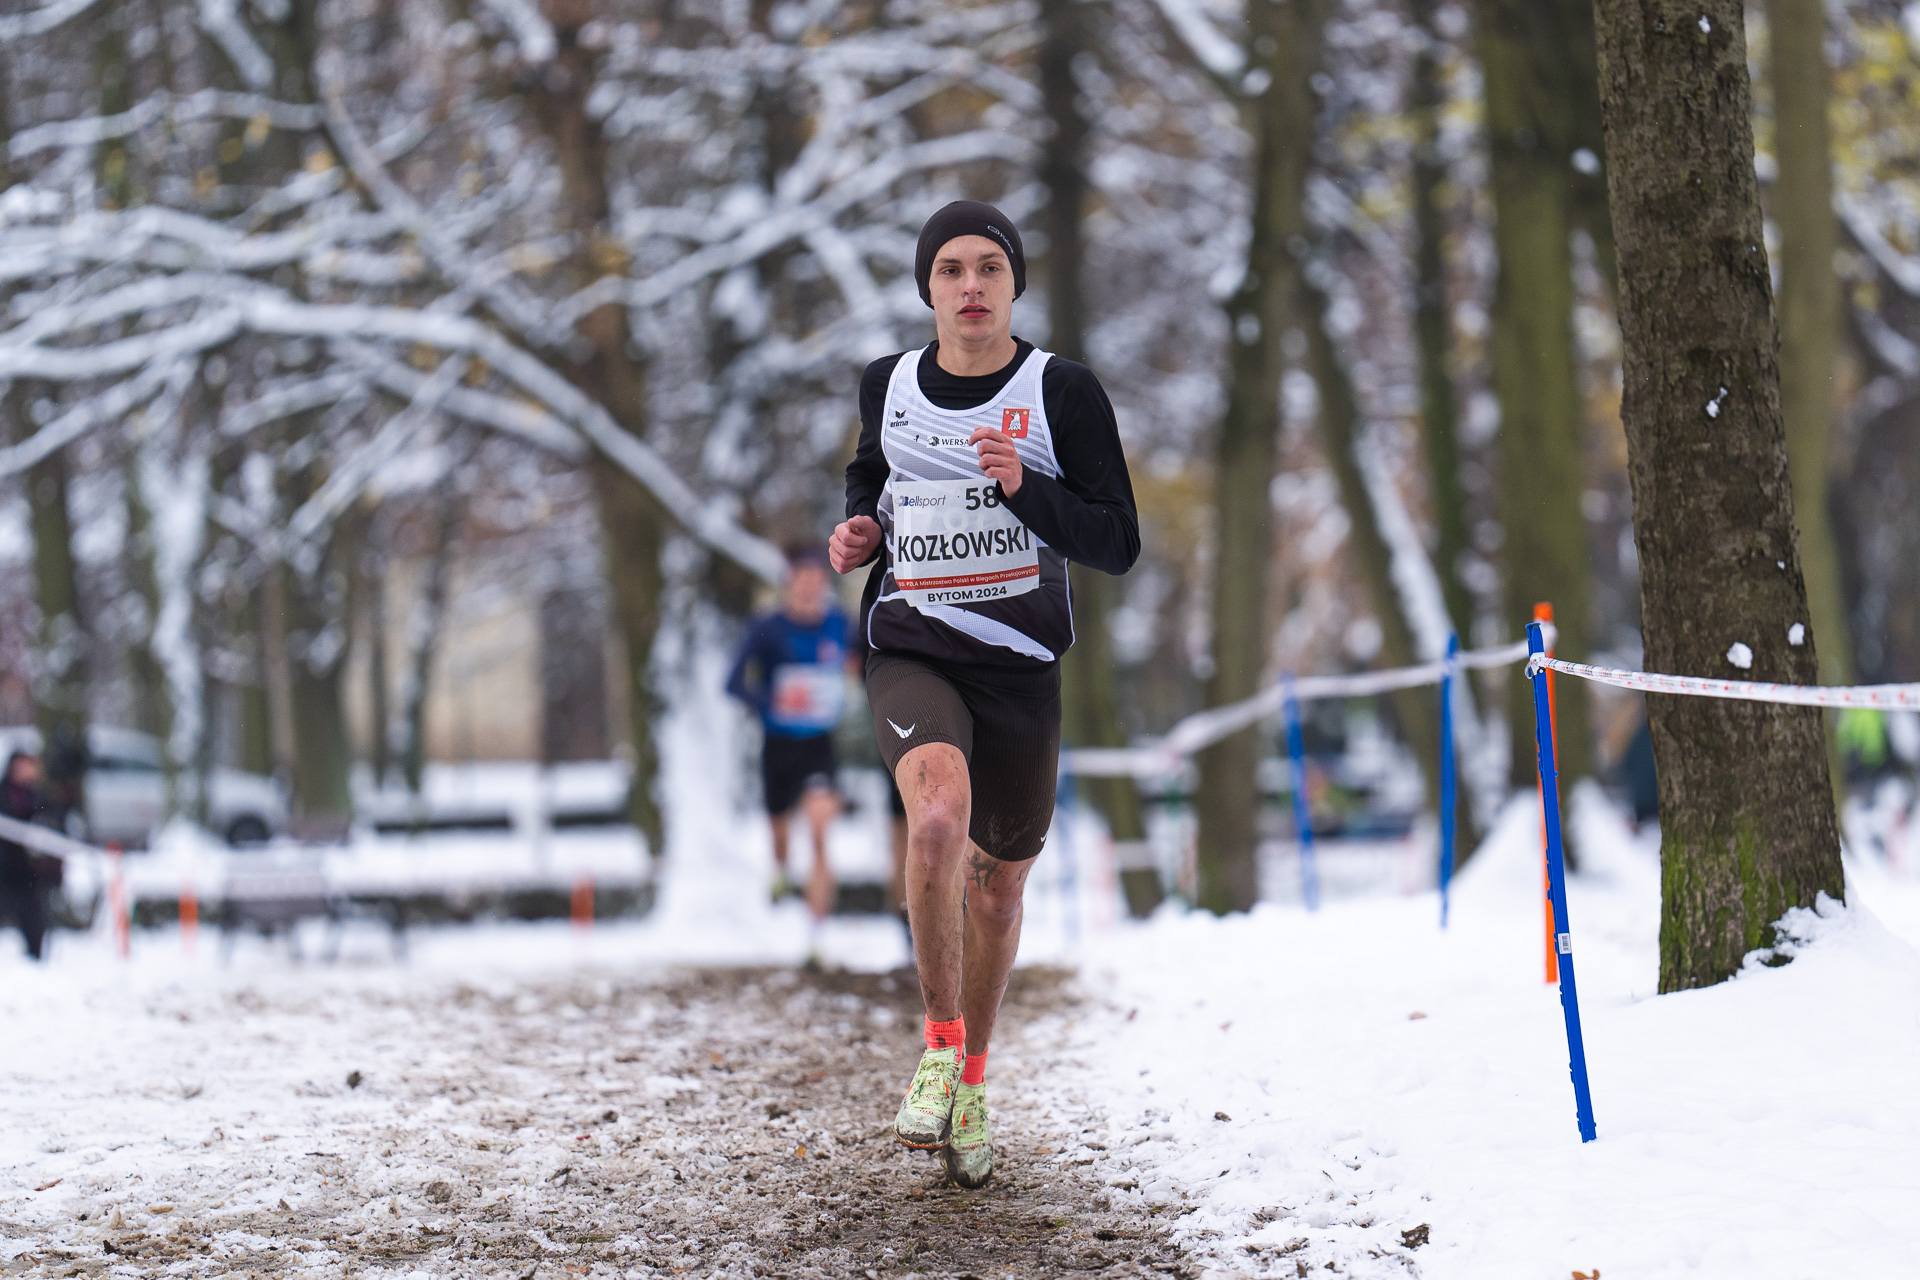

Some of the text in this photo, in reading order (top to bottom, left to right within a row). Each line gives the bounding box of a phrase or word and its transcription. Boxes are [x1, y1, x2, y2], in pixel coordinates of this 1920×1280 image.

[890, 420, 909, 428] erima
[941, 438, 970, 446] WERSA
[898, 525, 1030, 563] KOZŁOWSKI
[975, 574, 1000, 583] Biegach
[927, 585, 1008, 602] BYTOM 2024
